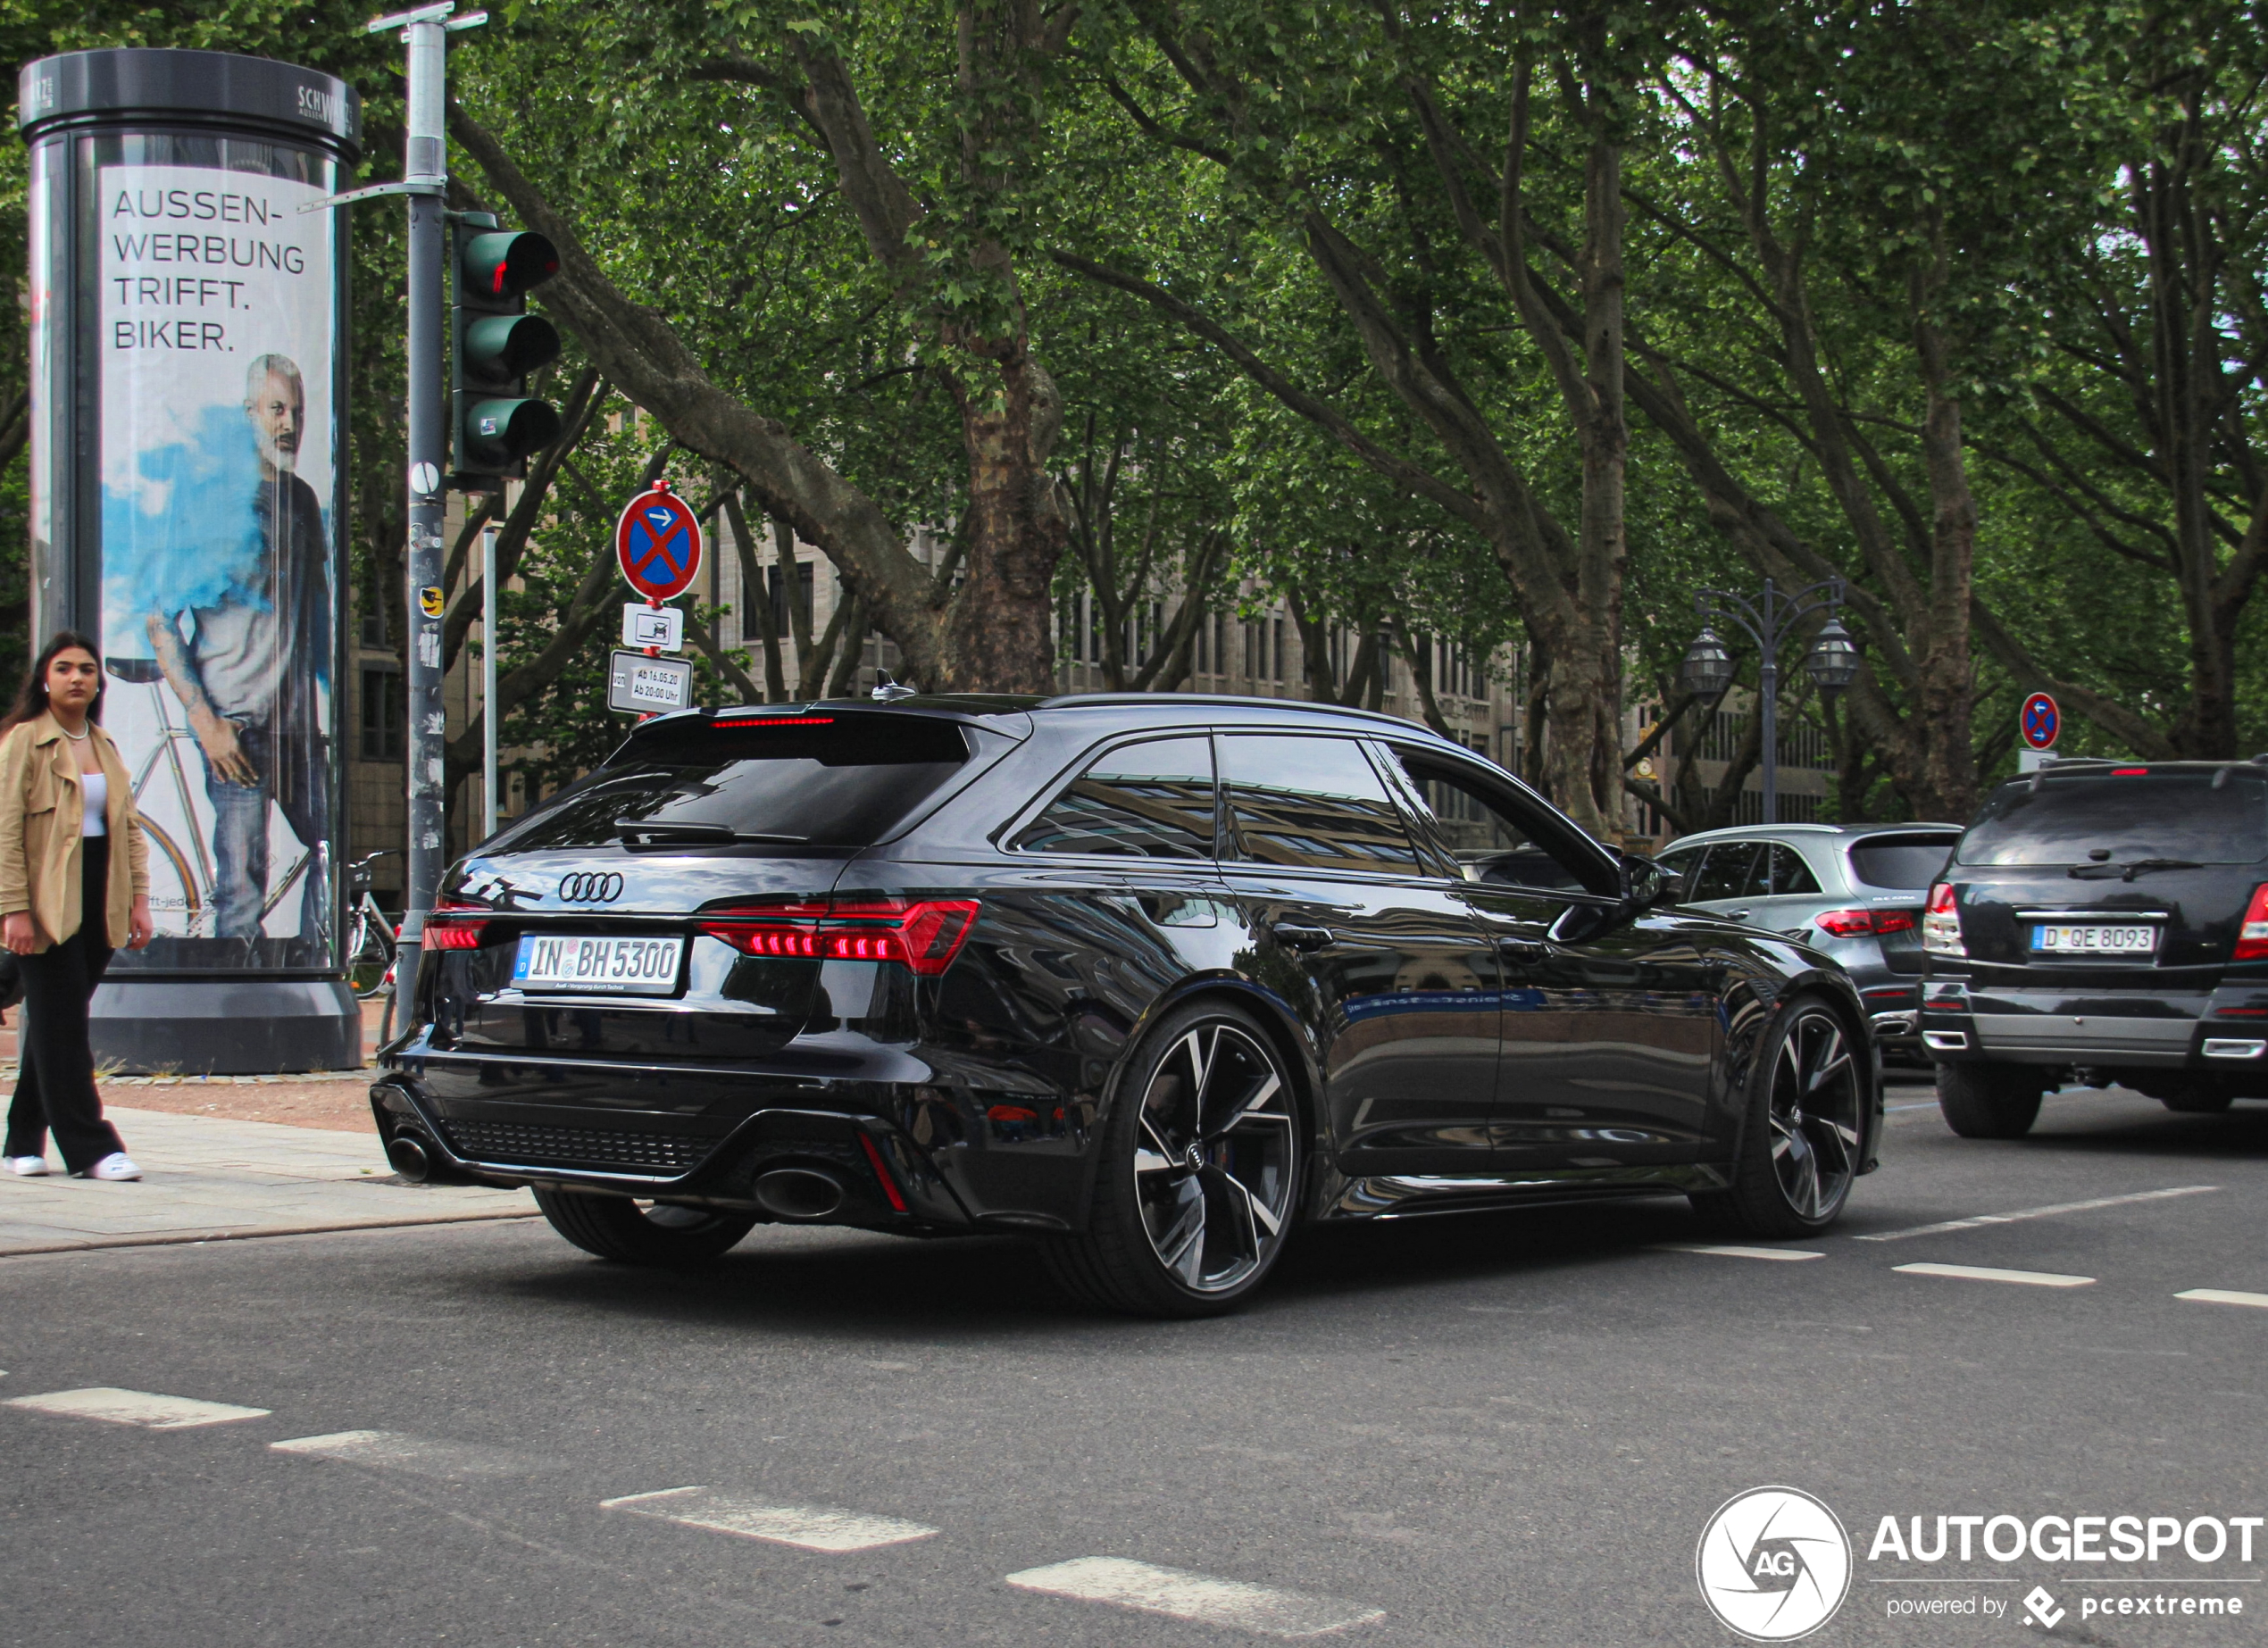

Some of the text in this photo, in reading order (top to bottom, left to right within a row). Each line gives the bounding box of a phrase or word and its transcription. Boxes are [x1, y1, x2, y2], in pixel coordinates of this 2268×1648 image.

[113, 190, 282, 226] AUSSEN-
[113, 234, 304, 275] WERBUNG
[113, 278, 249, 310] TRIFFT.
[115, 320, 234, 352] BIKER.
[634, 684, 679, 701] Ab 20:00 Uhr
[638, 670, 678, 685] Ab 16.05.20
[2045, 928, 2149, 947] D QE 8093
[520, 961, 527, 972] D
[533, 940, 676, 978] IN BH 5300
